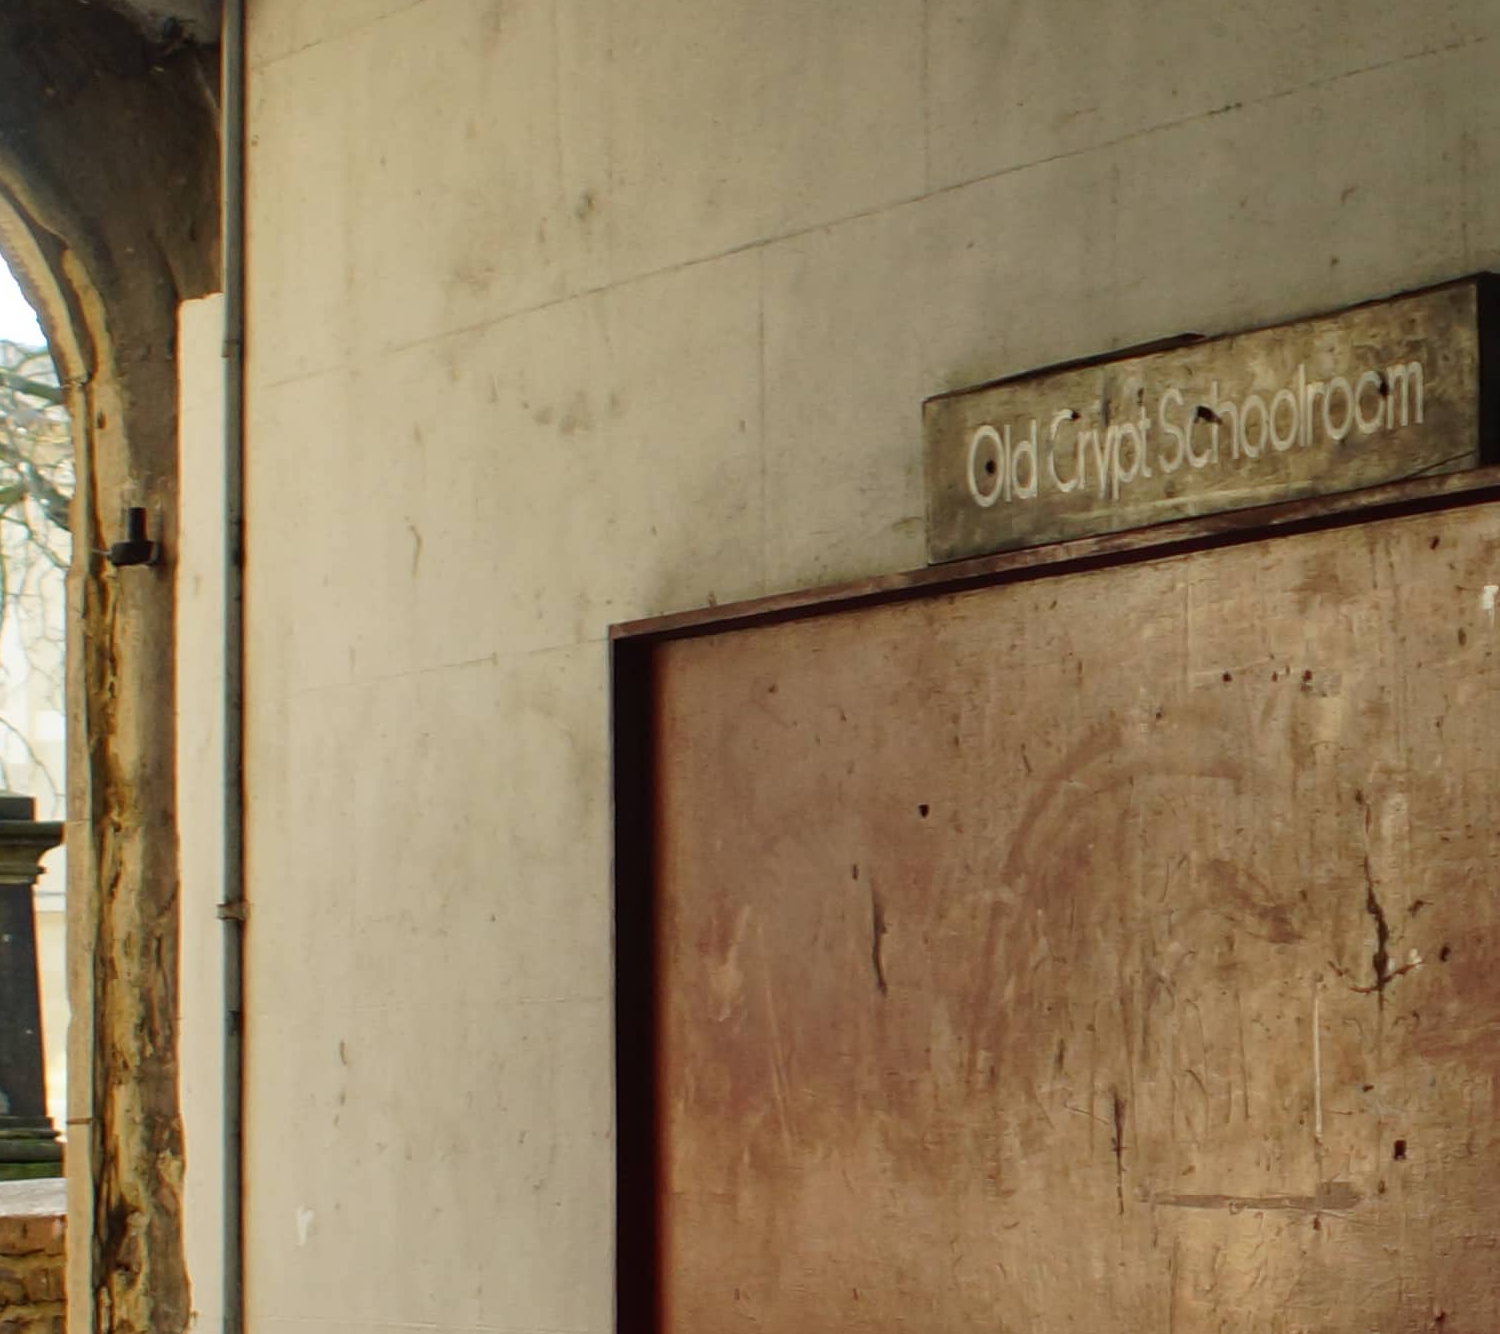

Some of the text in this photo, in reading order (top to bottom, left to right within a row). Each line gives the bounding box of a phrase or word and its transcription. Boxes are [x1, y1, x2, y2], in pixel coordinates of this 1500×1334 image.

[967, 361, 1425, 508] Old Crypt Schoolroom
